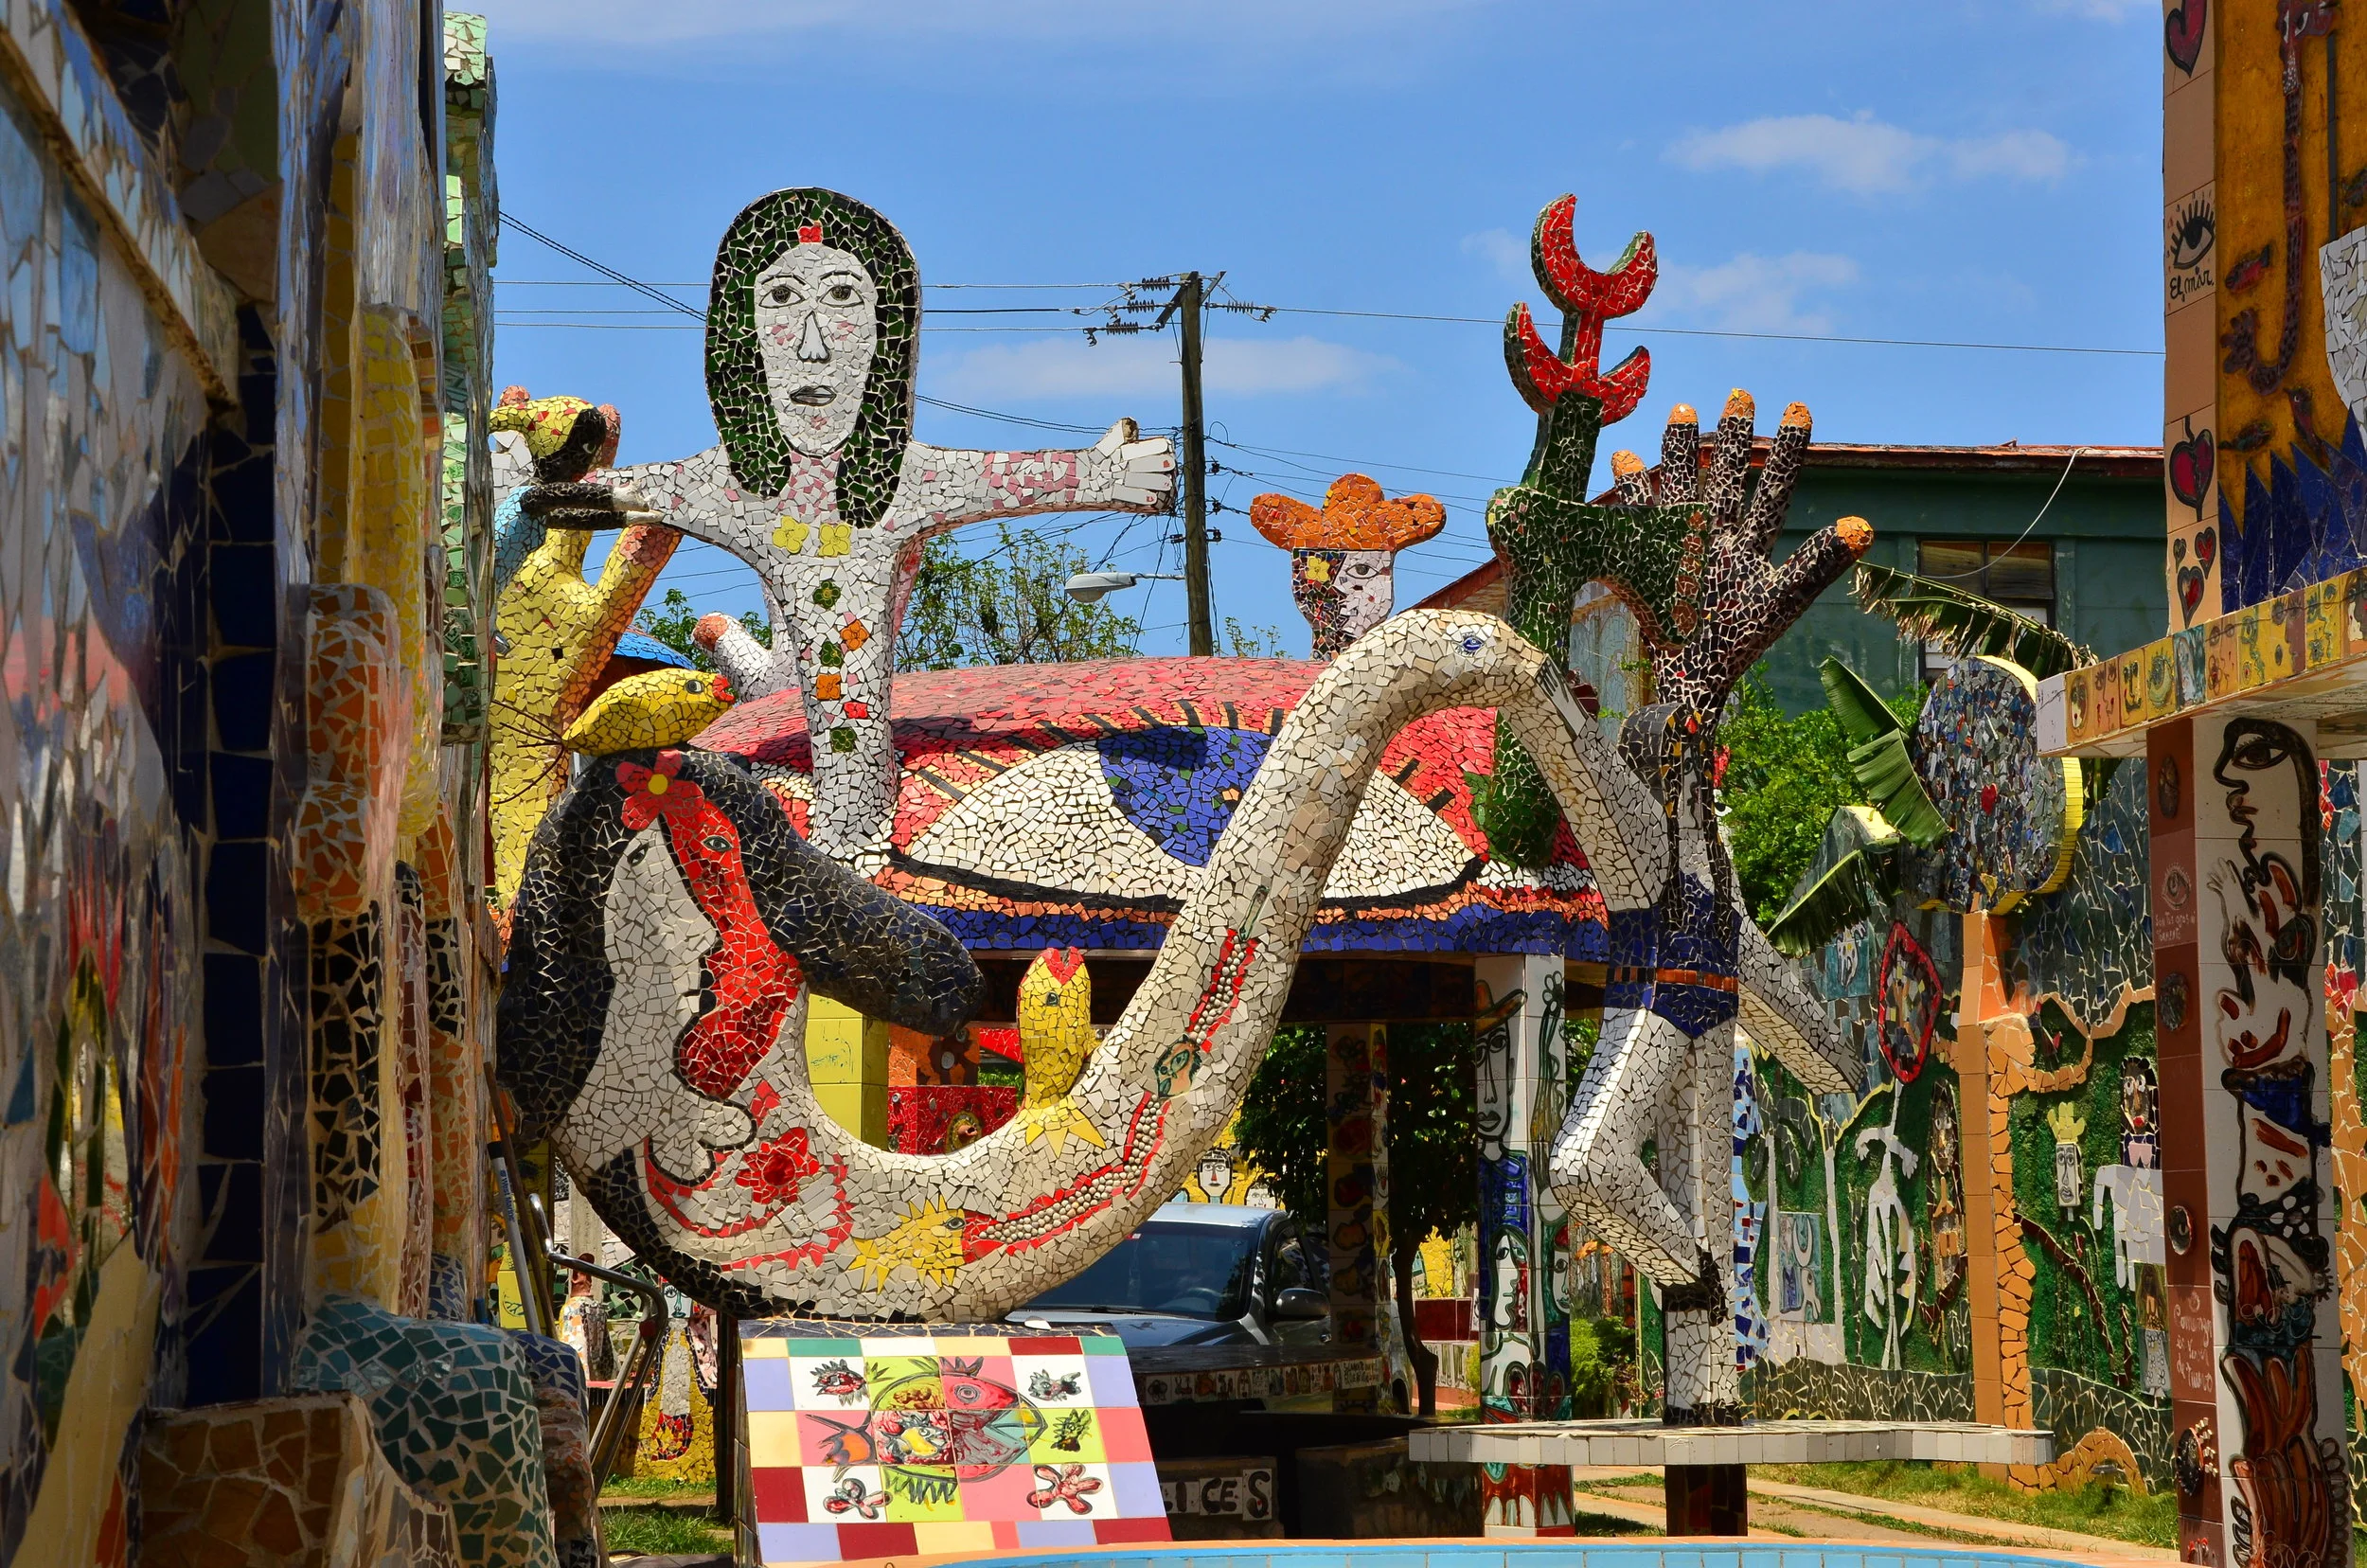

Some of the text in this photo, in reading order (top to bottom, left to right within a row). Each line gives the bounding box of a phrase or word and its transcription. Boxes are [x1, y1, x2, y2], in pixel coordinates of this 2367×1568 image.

[501, 1177, 515, 1221] West Marine
[1164, 1470, 1271, 1519] ICES
